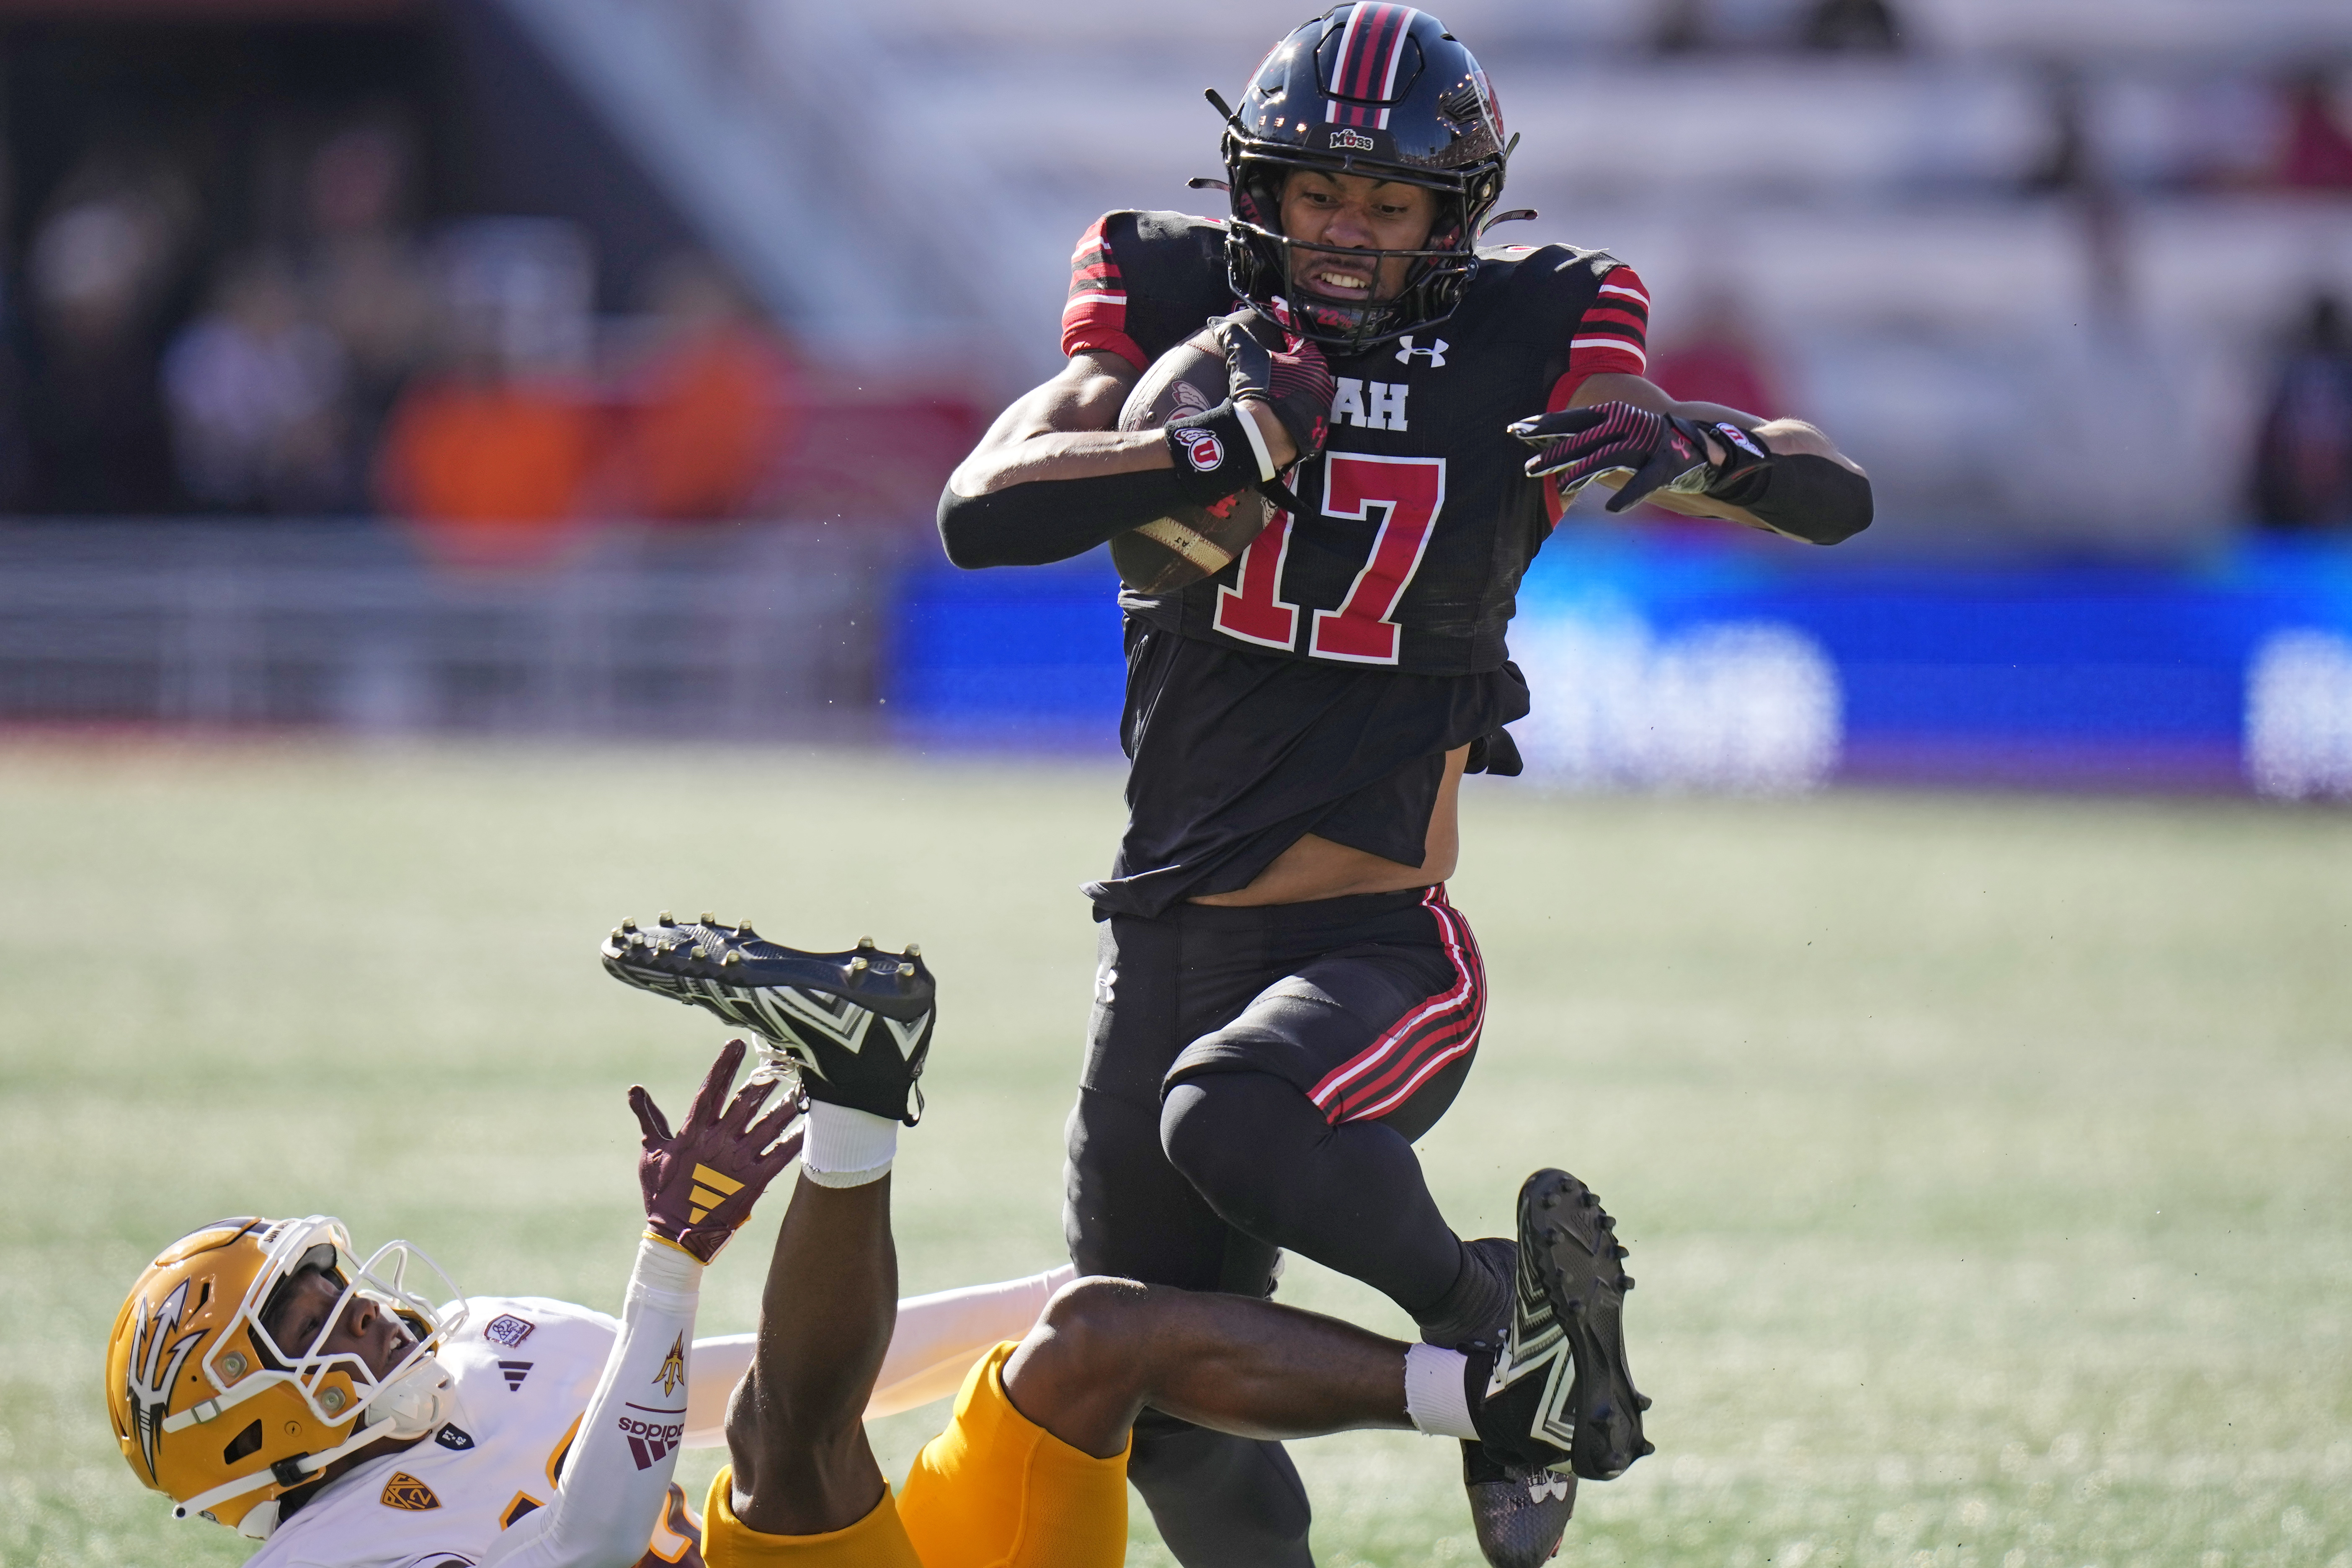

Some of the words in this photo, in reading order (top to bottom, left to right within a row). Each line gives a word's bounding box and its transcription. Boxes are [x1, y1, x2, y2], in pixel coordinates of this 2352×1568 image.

[1317, 309, 1353, 328] 22%
[1330, 376, 1409, 432] AH
[1193, 440, 1218, 463] U
[1212, 450, 1446, 665] 17
[618, 1417, 684, 1442] adidas
[383, 1474, 426, 1509] PAC
[407, 1488, 432, 1509] 12
